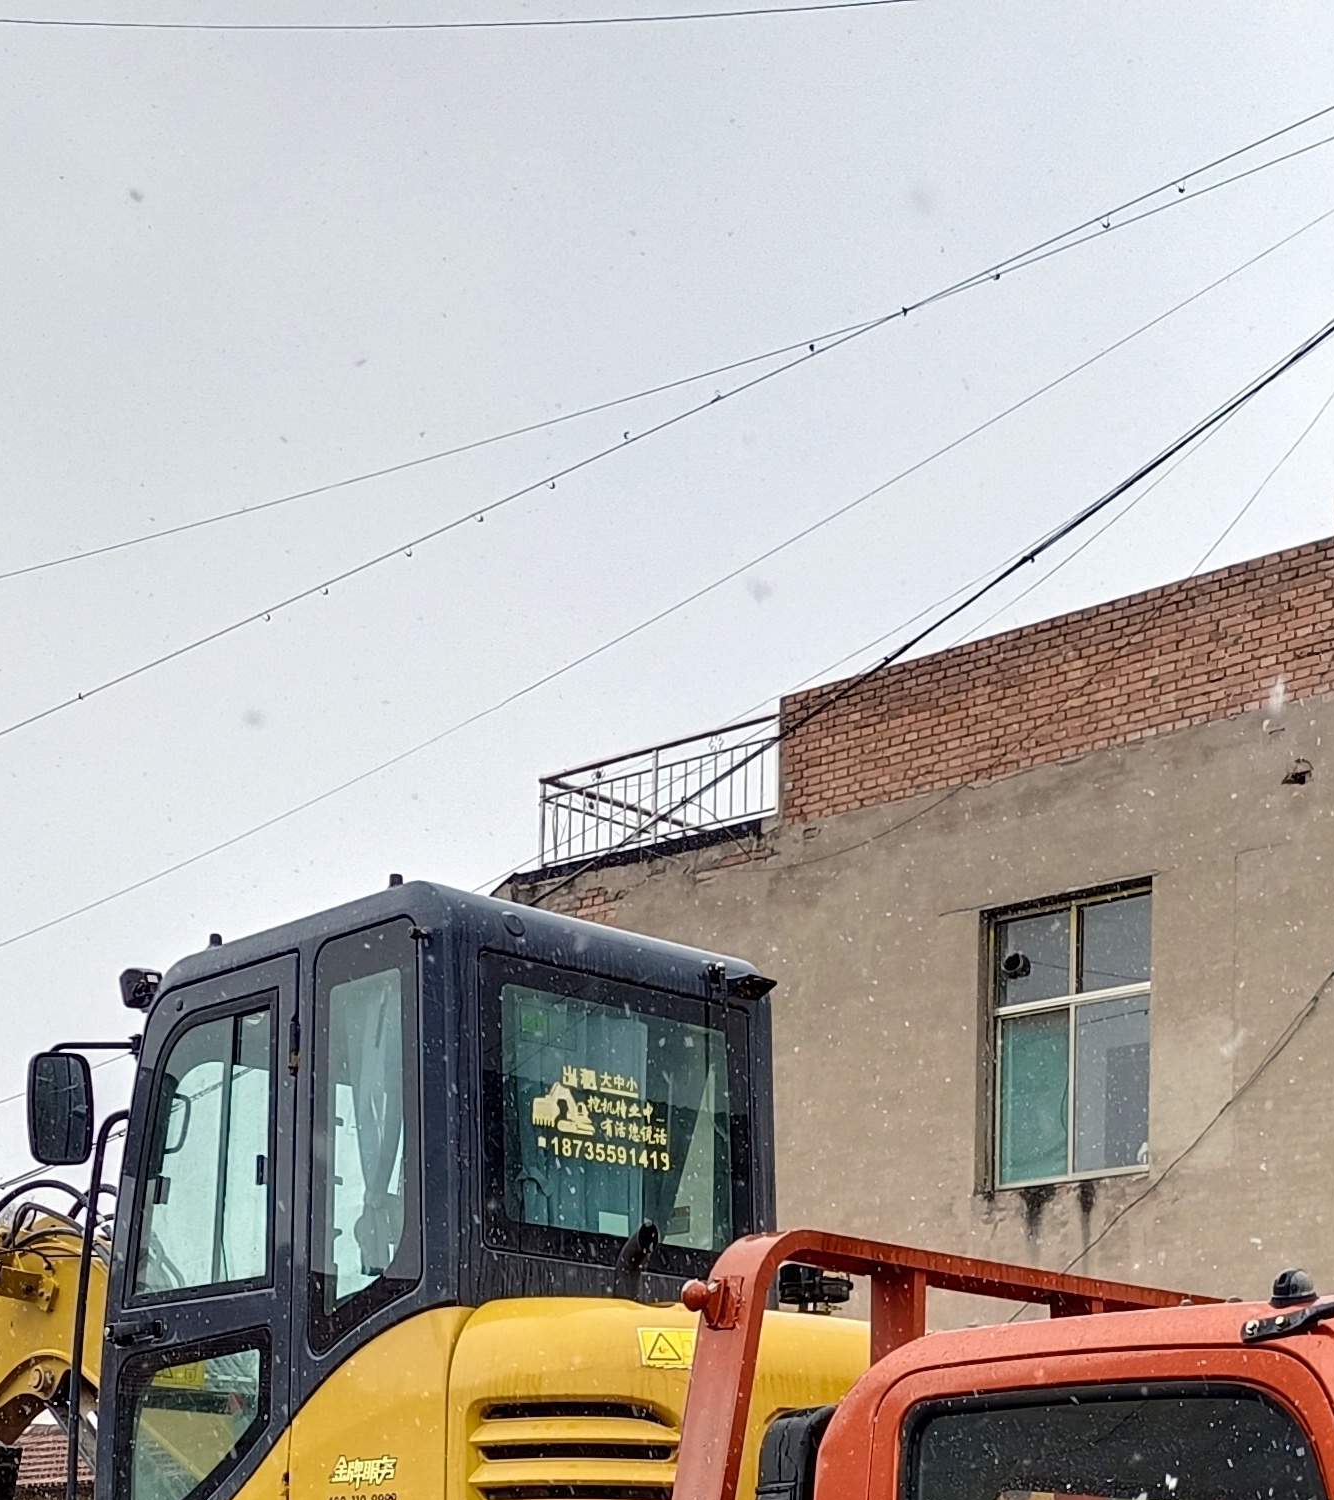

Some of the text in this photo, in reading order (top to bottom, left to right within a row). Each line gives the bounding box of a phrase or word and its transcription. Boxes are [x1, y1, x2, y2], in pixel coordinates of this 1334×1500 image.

[600, 1072, 638, 1092] 大中小
[551, 1136, 670, 1171] 18735591419
[330, 1455, 398, 1491] 金牌服务
